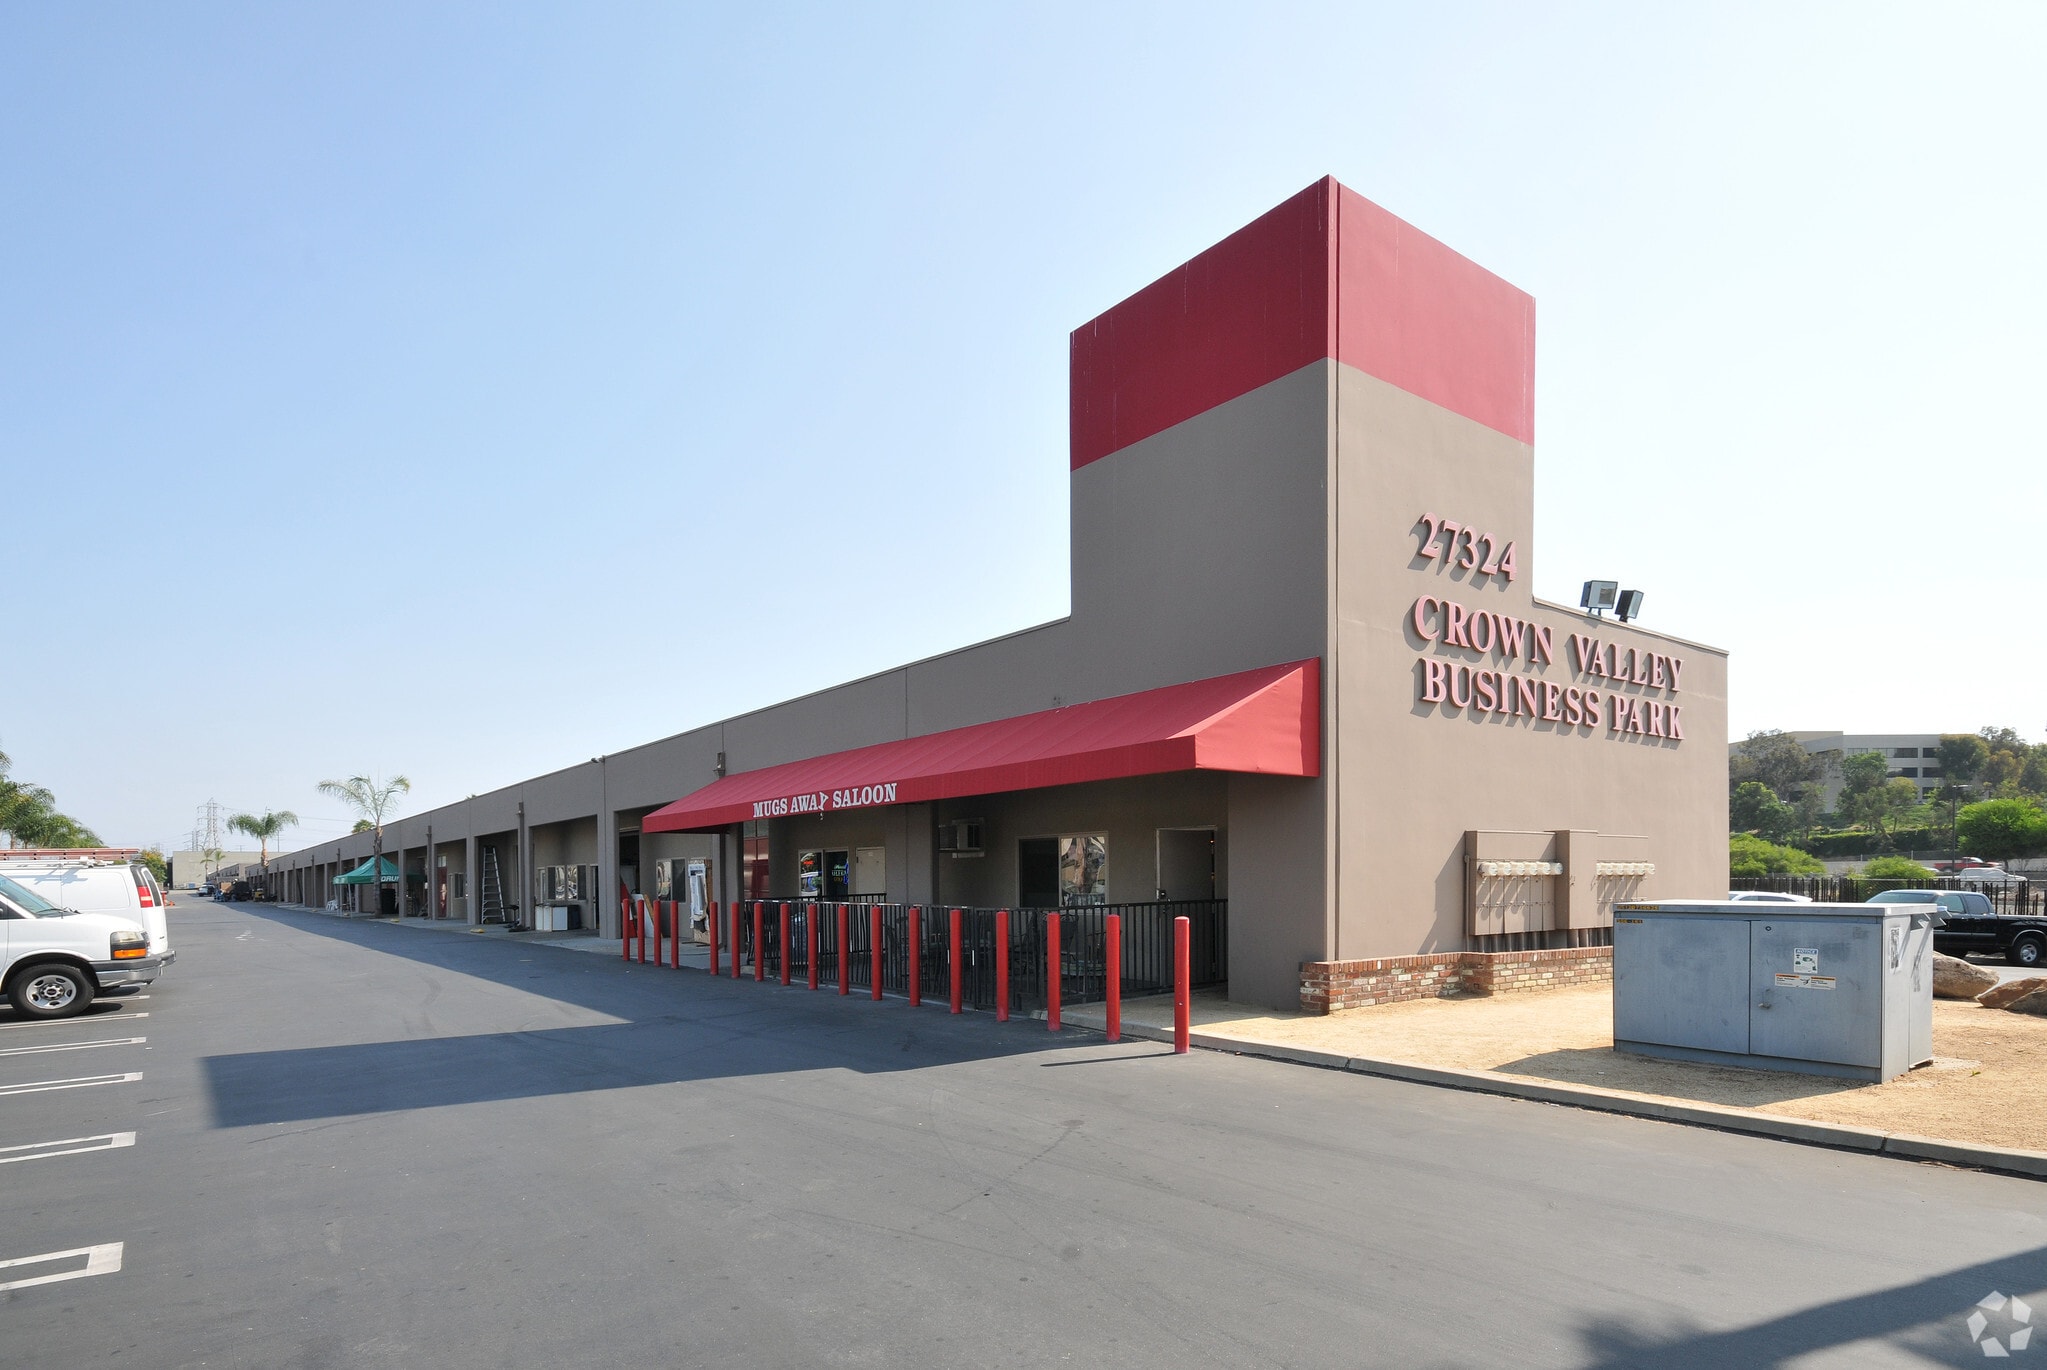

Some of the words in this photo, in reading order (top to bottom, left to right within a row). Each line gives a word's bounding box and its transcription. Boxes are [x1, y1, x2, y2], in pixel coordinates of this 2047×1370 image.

[1418, 512, 1518, 582] 27324
[1413, 594, 1554, 666] CROWN
[1570, 633, 1686, 692] VALLEY
[1418, 657, 1602, 728] BUSINESS
[1609, 694, 1685, 741] PARK
[752, 798, 788, 818] MUGS
[790, 791, 829, 811] AWAY
[832, 782, 898, 809] SALOON
